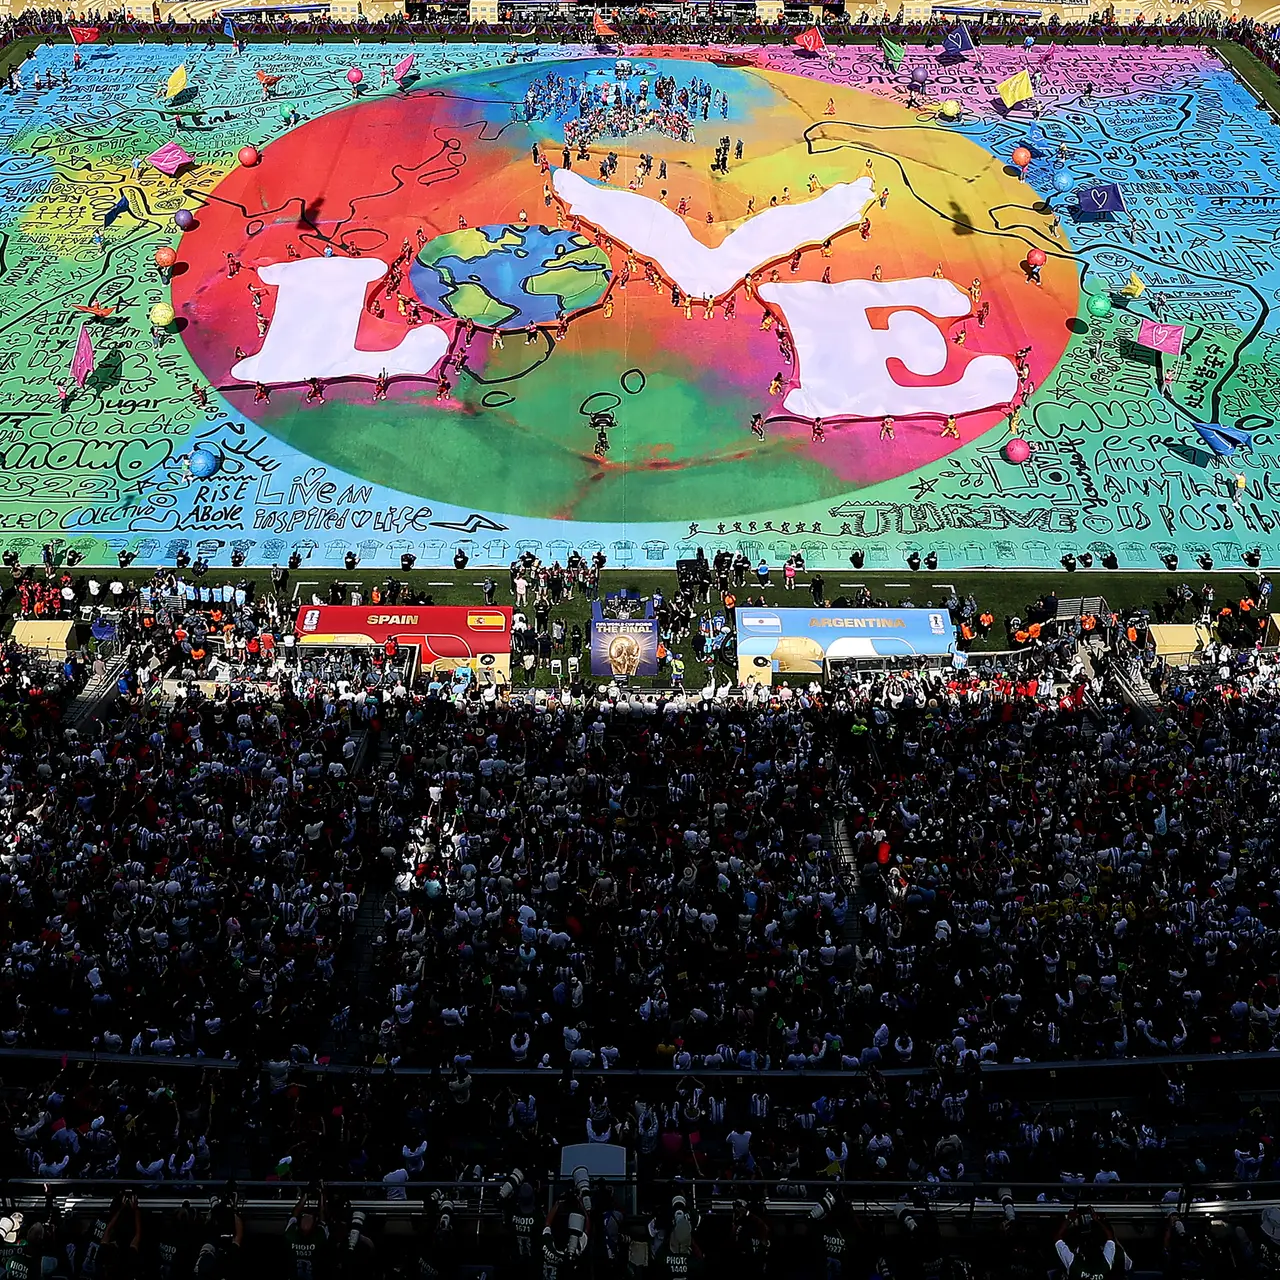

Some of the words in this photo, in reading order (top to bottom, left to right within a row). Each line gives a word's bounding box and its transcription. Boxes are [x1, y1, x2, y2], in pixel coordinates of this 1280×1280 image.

[5, 194, 82, 204] READING
[1145, 196, 1162, 206] BY
[1166, 195, 1198, 206] LOVE
[19, 235, 50, 245] END
[37, 244, 72, 253] NOW
[88, 397, 161, 417] jugar
[29, 413, 99, 438] Côte
[120, 413, 191, 437] côte
[1033, 400, 1172, 440] MUSIC
[1036, 440, 1082, 507] LOVE
[337, 484, 373, 506] AN
[832, 501, 1078, 536] THRIVE
[367, 615, 418, 625] SPAIN
[809, 617, 905, 628] ARGENTINA
[597, 626, 617, 634] THE
[619, 626, 652, 634] FINAL
